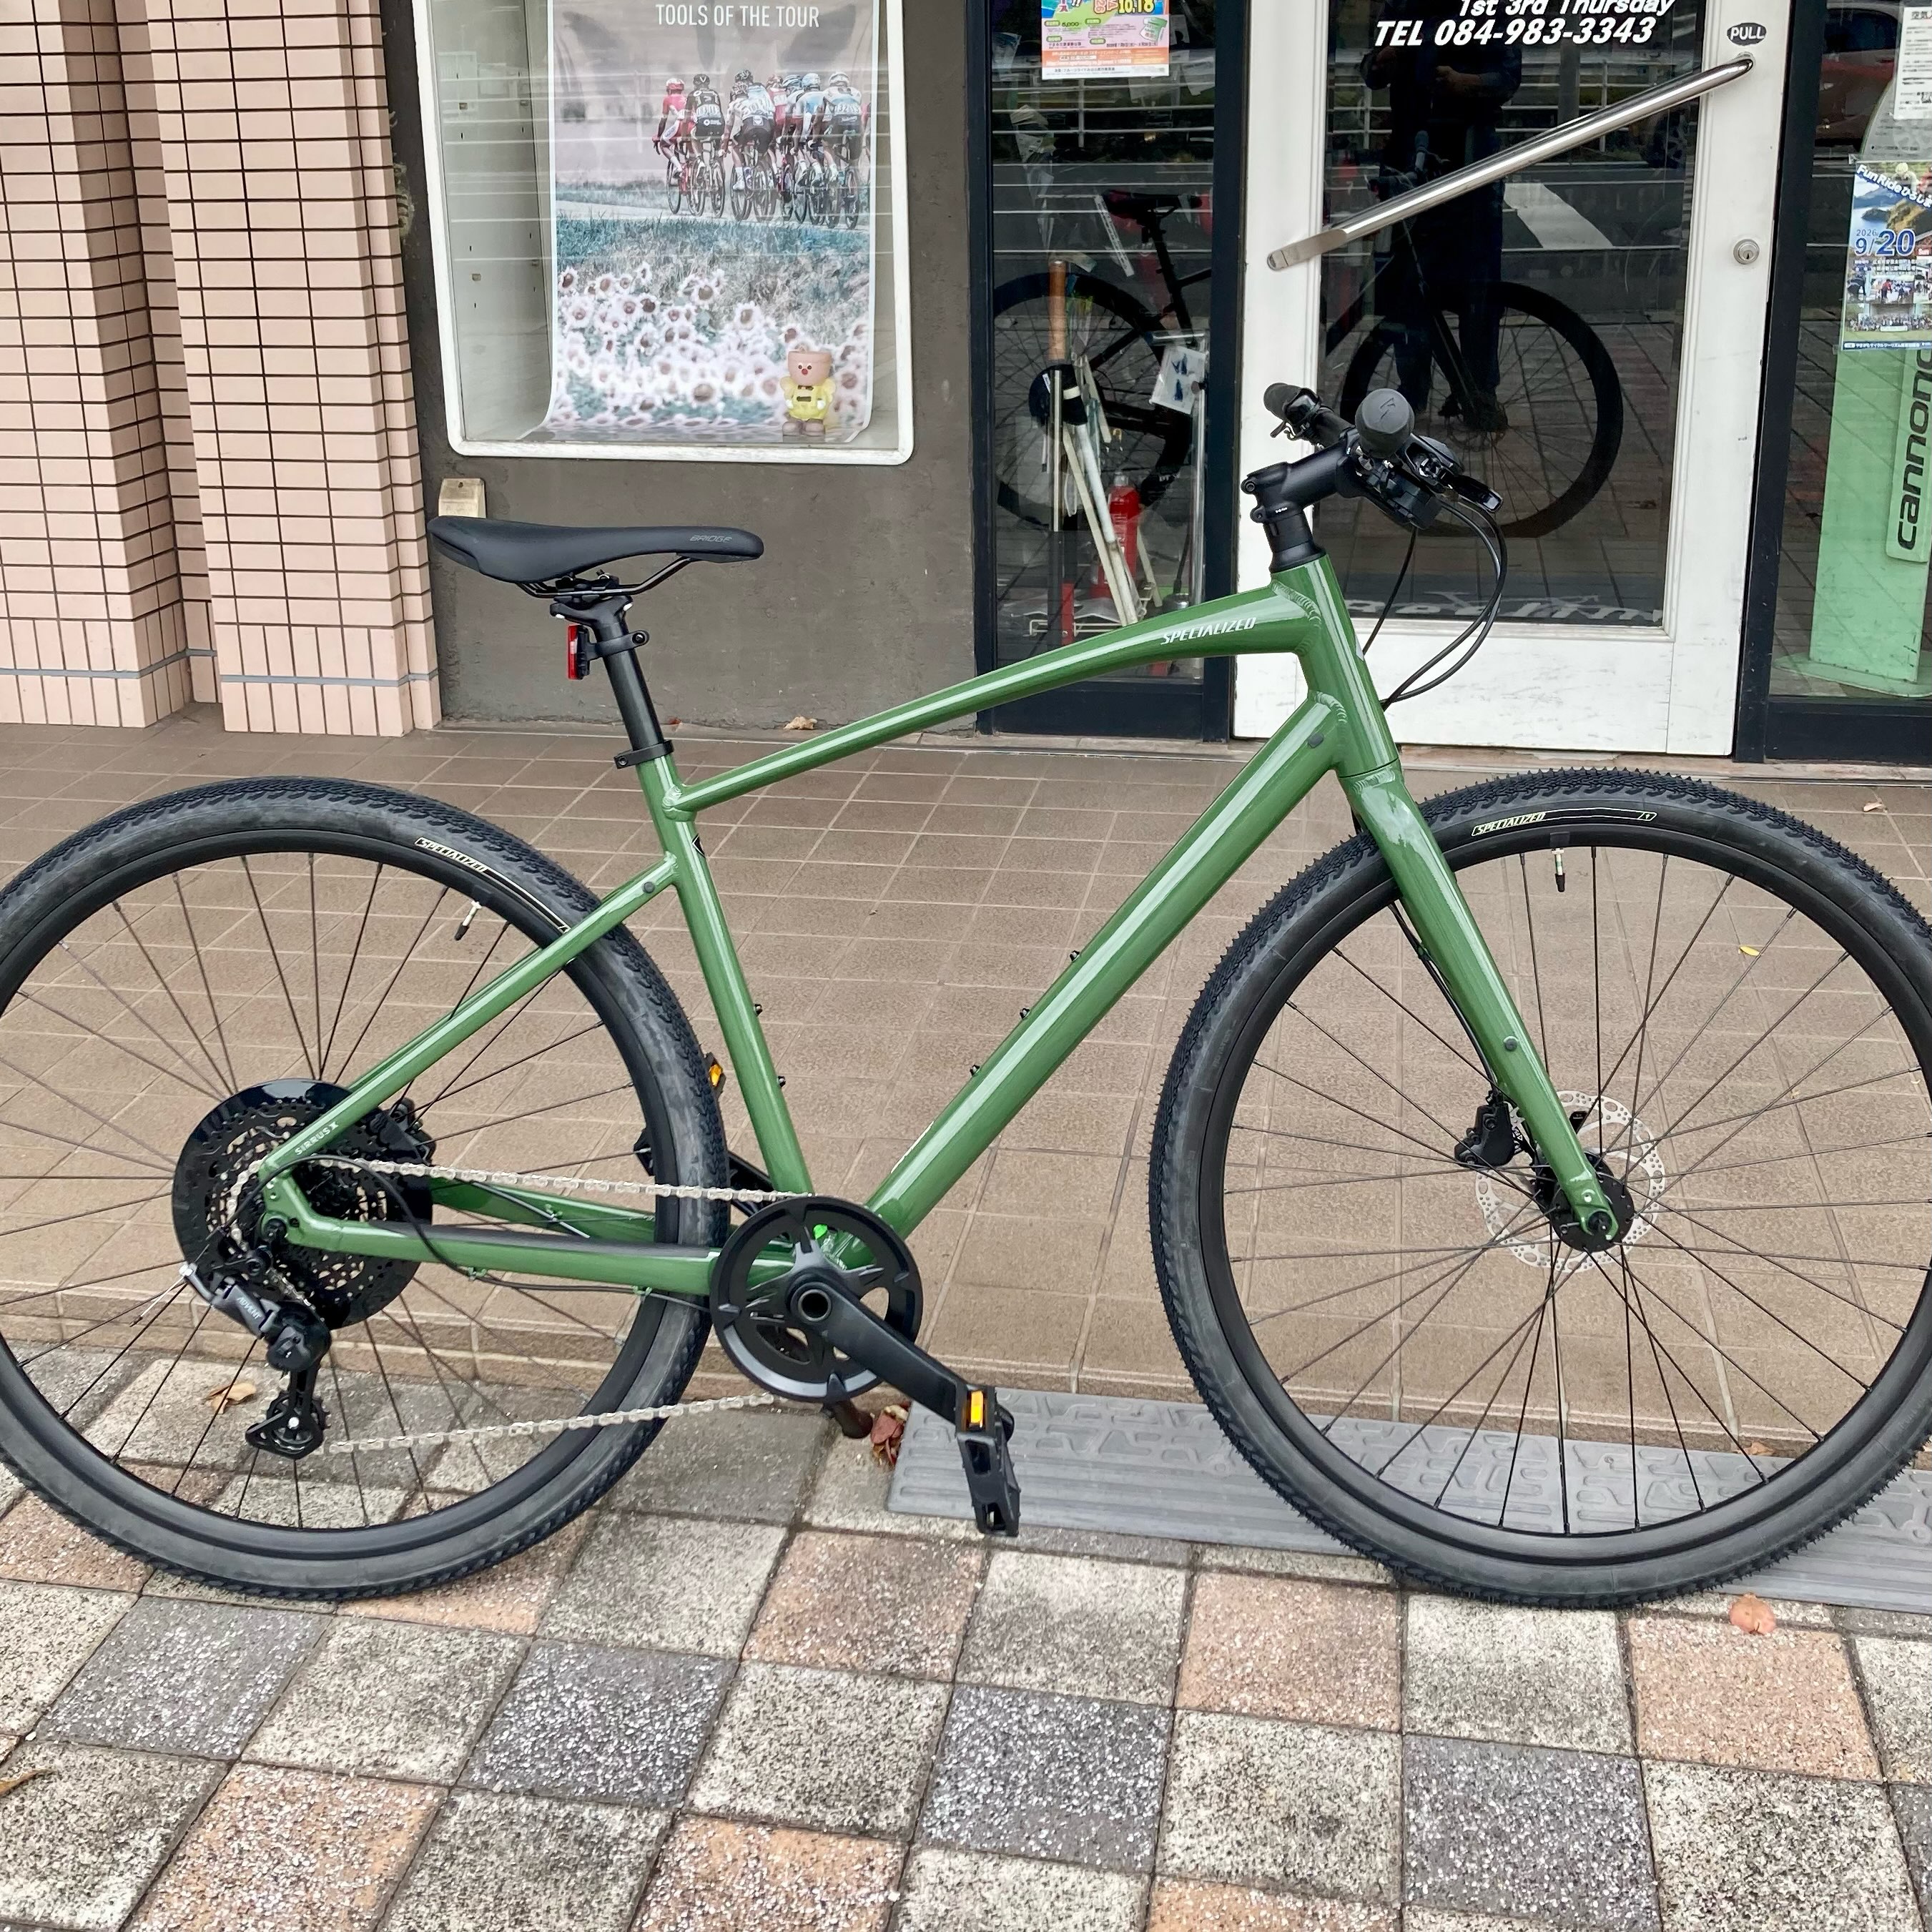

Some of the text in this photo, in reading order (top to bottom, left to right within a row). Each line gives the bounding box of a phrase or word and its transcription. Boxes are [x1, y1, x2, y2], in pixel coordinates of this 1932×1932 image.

[655, 4, 819, 28] TOOLS OF THE TOUR
[1375, 16, 1657, 46] TEL 084-983-3343
[1730, 26, 1765, 41] PULL
[1854, 230, 1916, 256] 9/20
[689, 534, 733, 543] BRIDGE
[1160, 616, 1257, 646] SPECIALIZED
[1476, 812, 1546, 835] SPECIALIZED
[420, 839, 488, 873] SPECIALIZED
[295, 1121, 339, 1155] SIRRUS X
[237, 1297, 262, 1320] ADVENT
